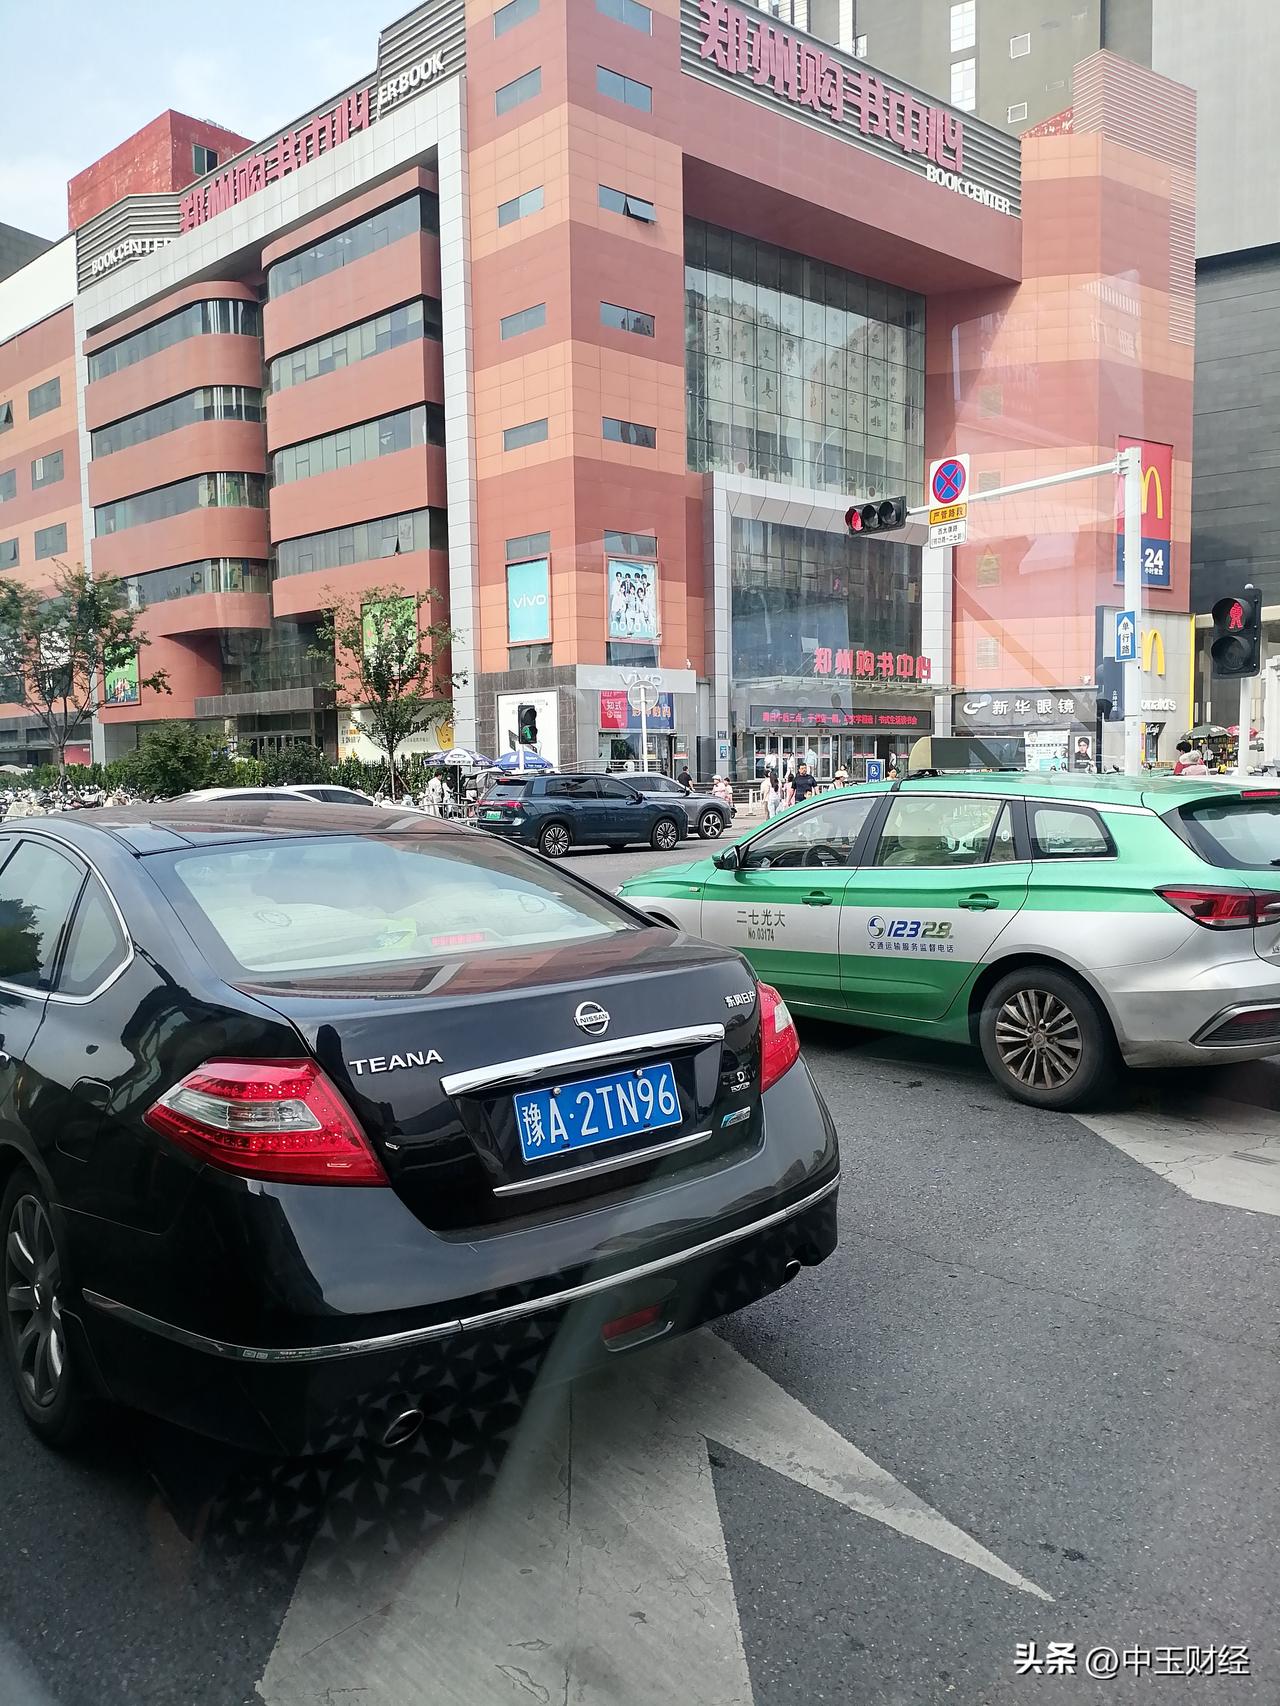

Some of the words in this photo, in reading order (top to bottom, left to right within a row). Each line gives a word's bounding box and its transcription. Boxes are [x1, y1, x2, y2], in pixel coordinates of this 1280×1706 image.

[699, 0, 964, 173] 郑州购书中心
[180, 89, 371, 233] 郑州购书中心
[927, 163, 963, 195] BOOK
[964, 182, 1011, 215] CENTER
[91, 247, 118, 275] BOOK
[933, 507, 964, 521] 严管路段
[1144, 547, 1164, 569] 24
[512, 592, 547, 609] vivo
[1121, 620, 1131, 654] 单行路
[814, 647, 931, 679] 郑州购书中心
[992, 698, 1075, 715] 新华眼镜
[1140, 698, 1177, 711] onald's
[737, 909, 785, 927] 二七光大
[887, 920, 952, 938] 12328
[869, 941, 954, 953] 交通运输服务监督电话
[725, 990, 756, 1008] 东风日产
[580, 1013, 608, 1024] NISSAN
[348, 1049, 444, 1076] TEANA
[522, 1072, 676, 1148] 豫A·2TN96
